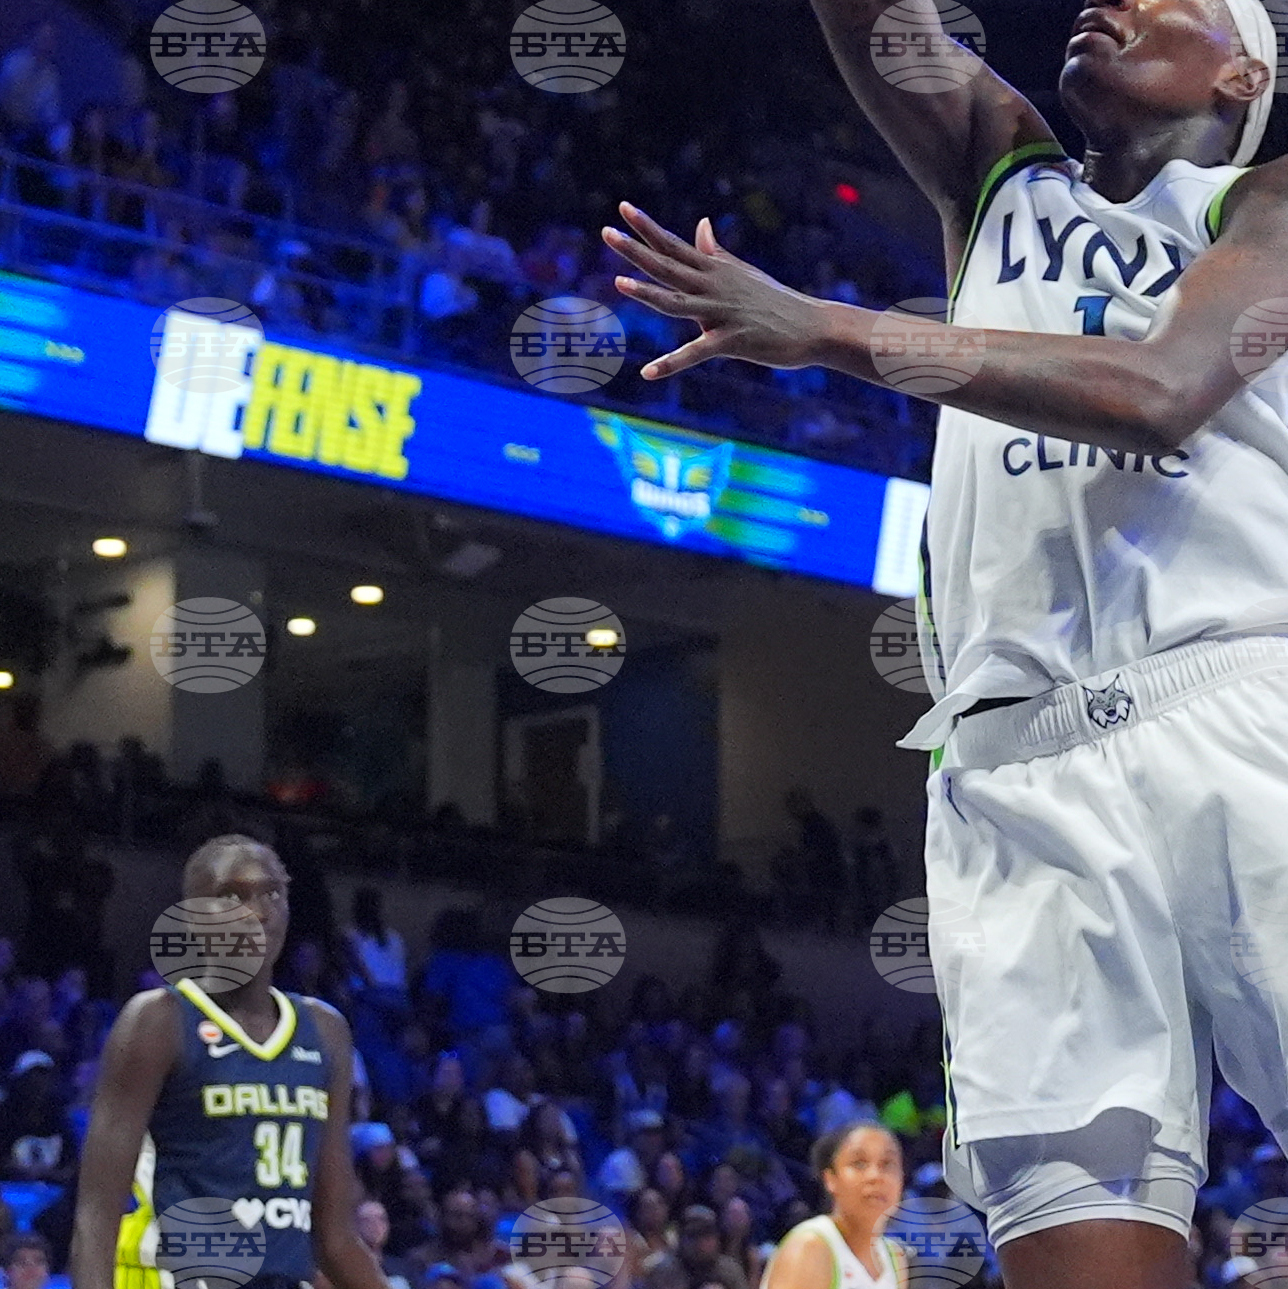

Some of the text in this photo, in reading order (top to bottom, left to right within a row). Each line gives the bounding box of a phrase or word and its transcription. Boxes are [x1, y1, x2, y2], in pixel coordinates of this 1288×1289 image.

[1003, 434, 1189, 478] CLINIC
[202, 1083, 329, 1121] DALLAS
[254, 1121, 309, 1188] 34
